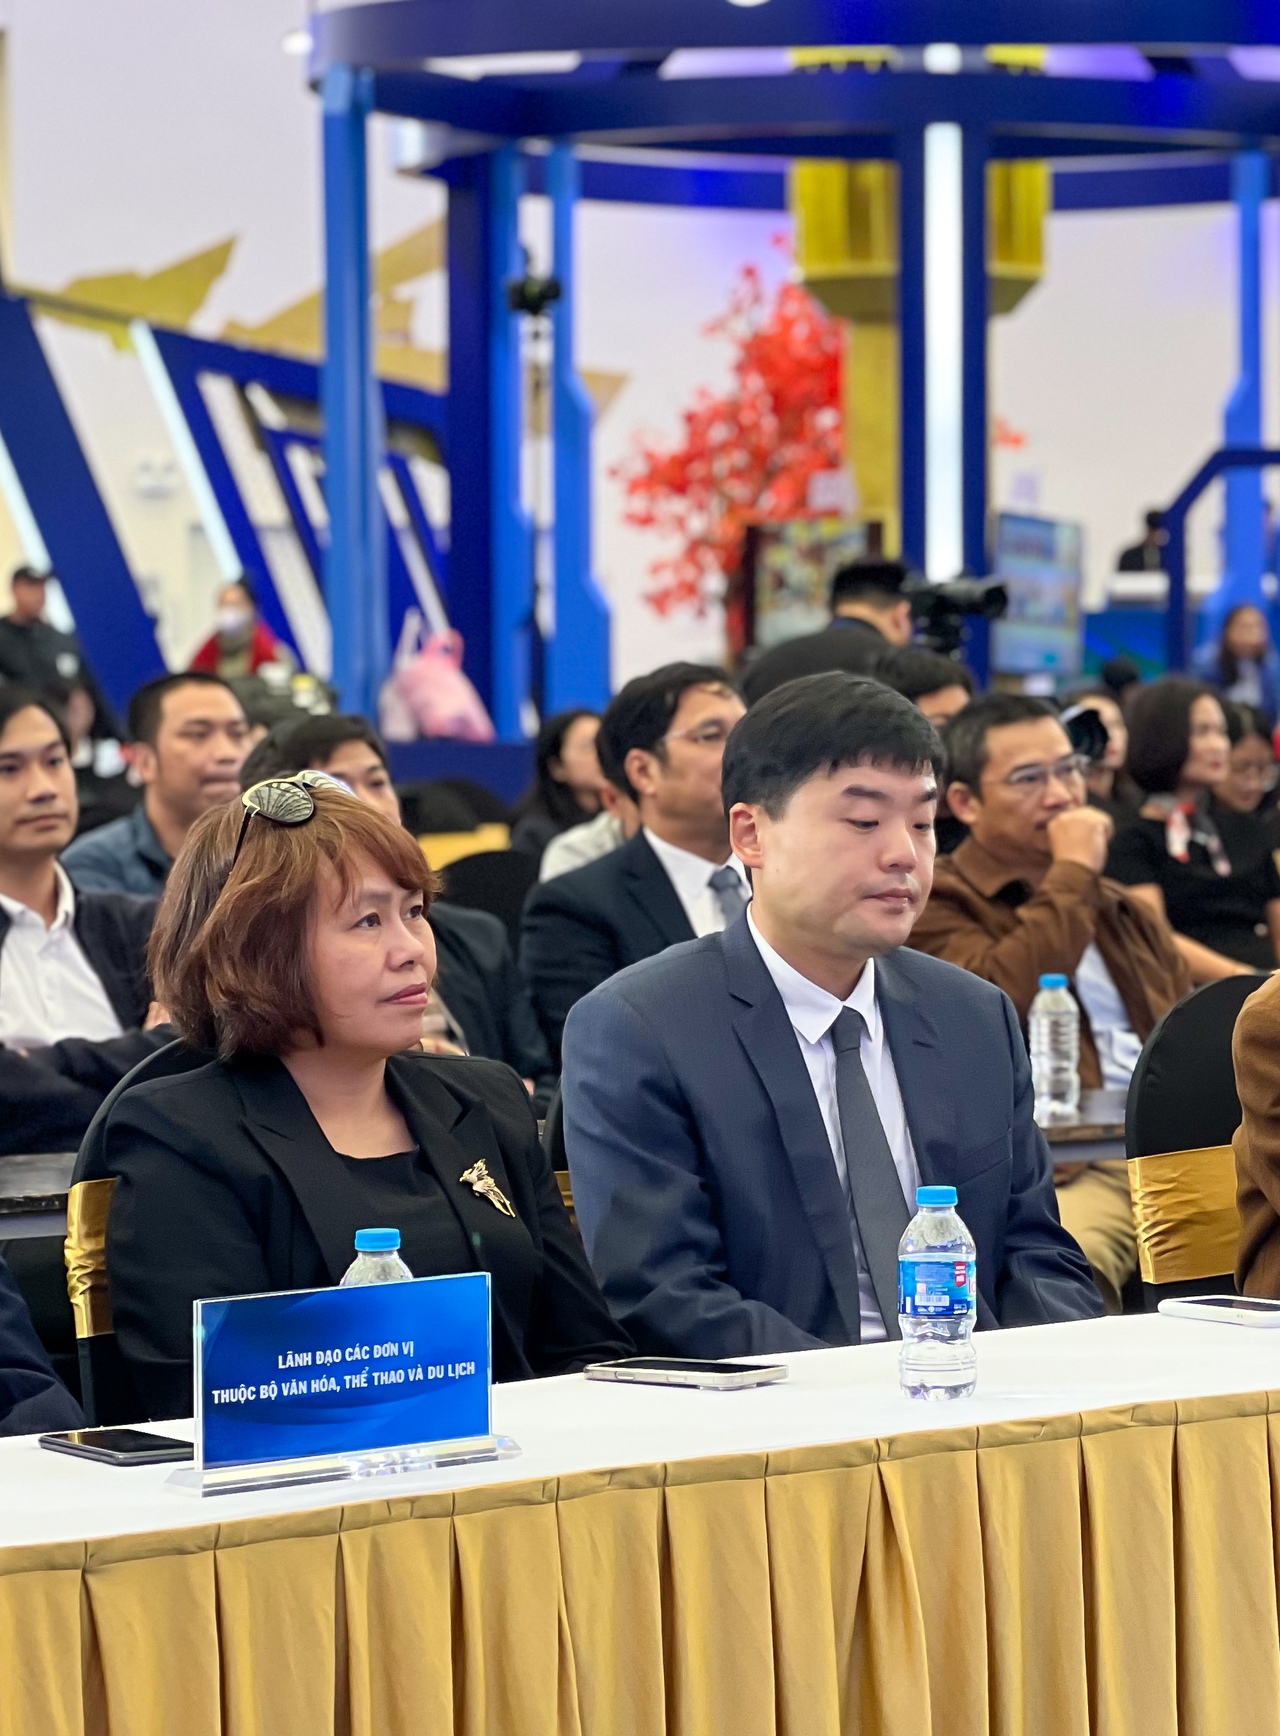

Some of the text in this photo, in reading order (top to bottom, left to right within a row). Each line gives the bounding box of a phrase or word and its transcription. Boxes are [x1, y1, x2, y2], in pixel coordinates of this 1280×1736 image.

[278, 1341, 414, 1369] LÃNH ĐẠO CÁC ĐƠN VỊ
[212, 1361, 476, 1404] THUỘC BỘ VĂN HÓA, THỂ THAO VÀ DU LỊCH
